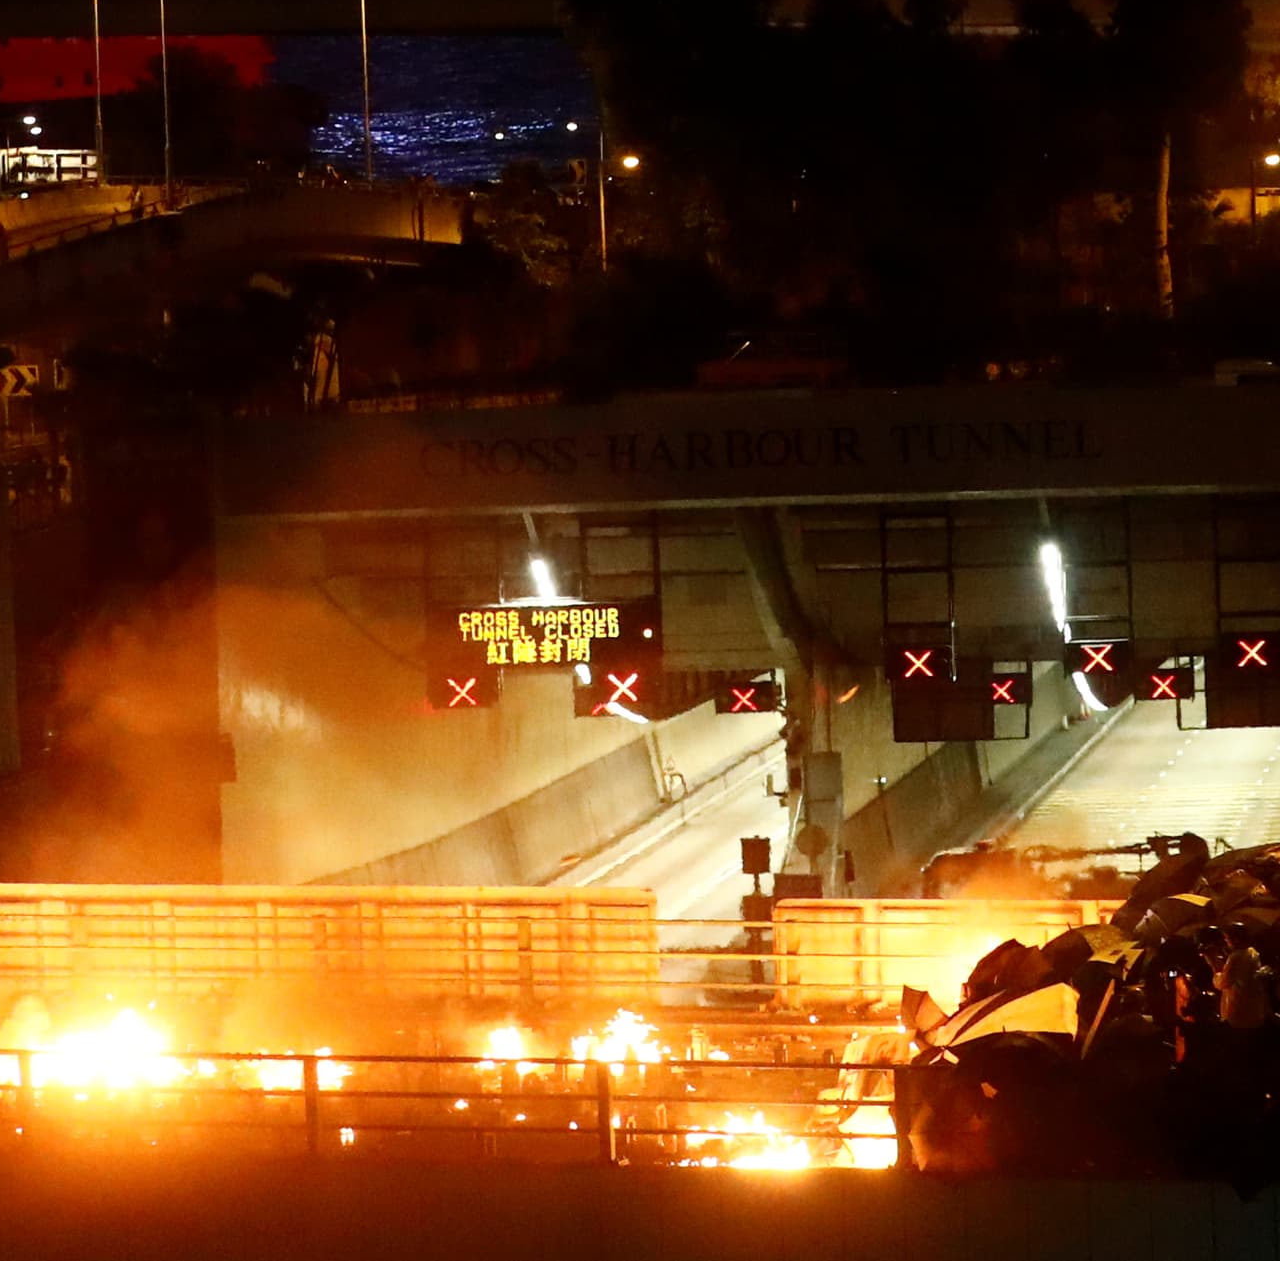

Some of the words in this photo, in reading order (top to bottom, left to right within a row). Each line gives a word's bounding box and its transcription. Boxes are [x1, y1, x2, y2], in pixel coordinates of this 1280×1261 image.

[419, 425, 867, 477] CROSS-HARBOUR
[892, 419, 1105, 464] TUNNEL
[458, 610, 519, 627] CROSS
[531, 608, 619, 626] HARBOUR
[461, 625, 532, 641] TUNNEL
[544, 623, 620, 640] CLOSED
[486, 638, 591, 664] 紅隧封閉
